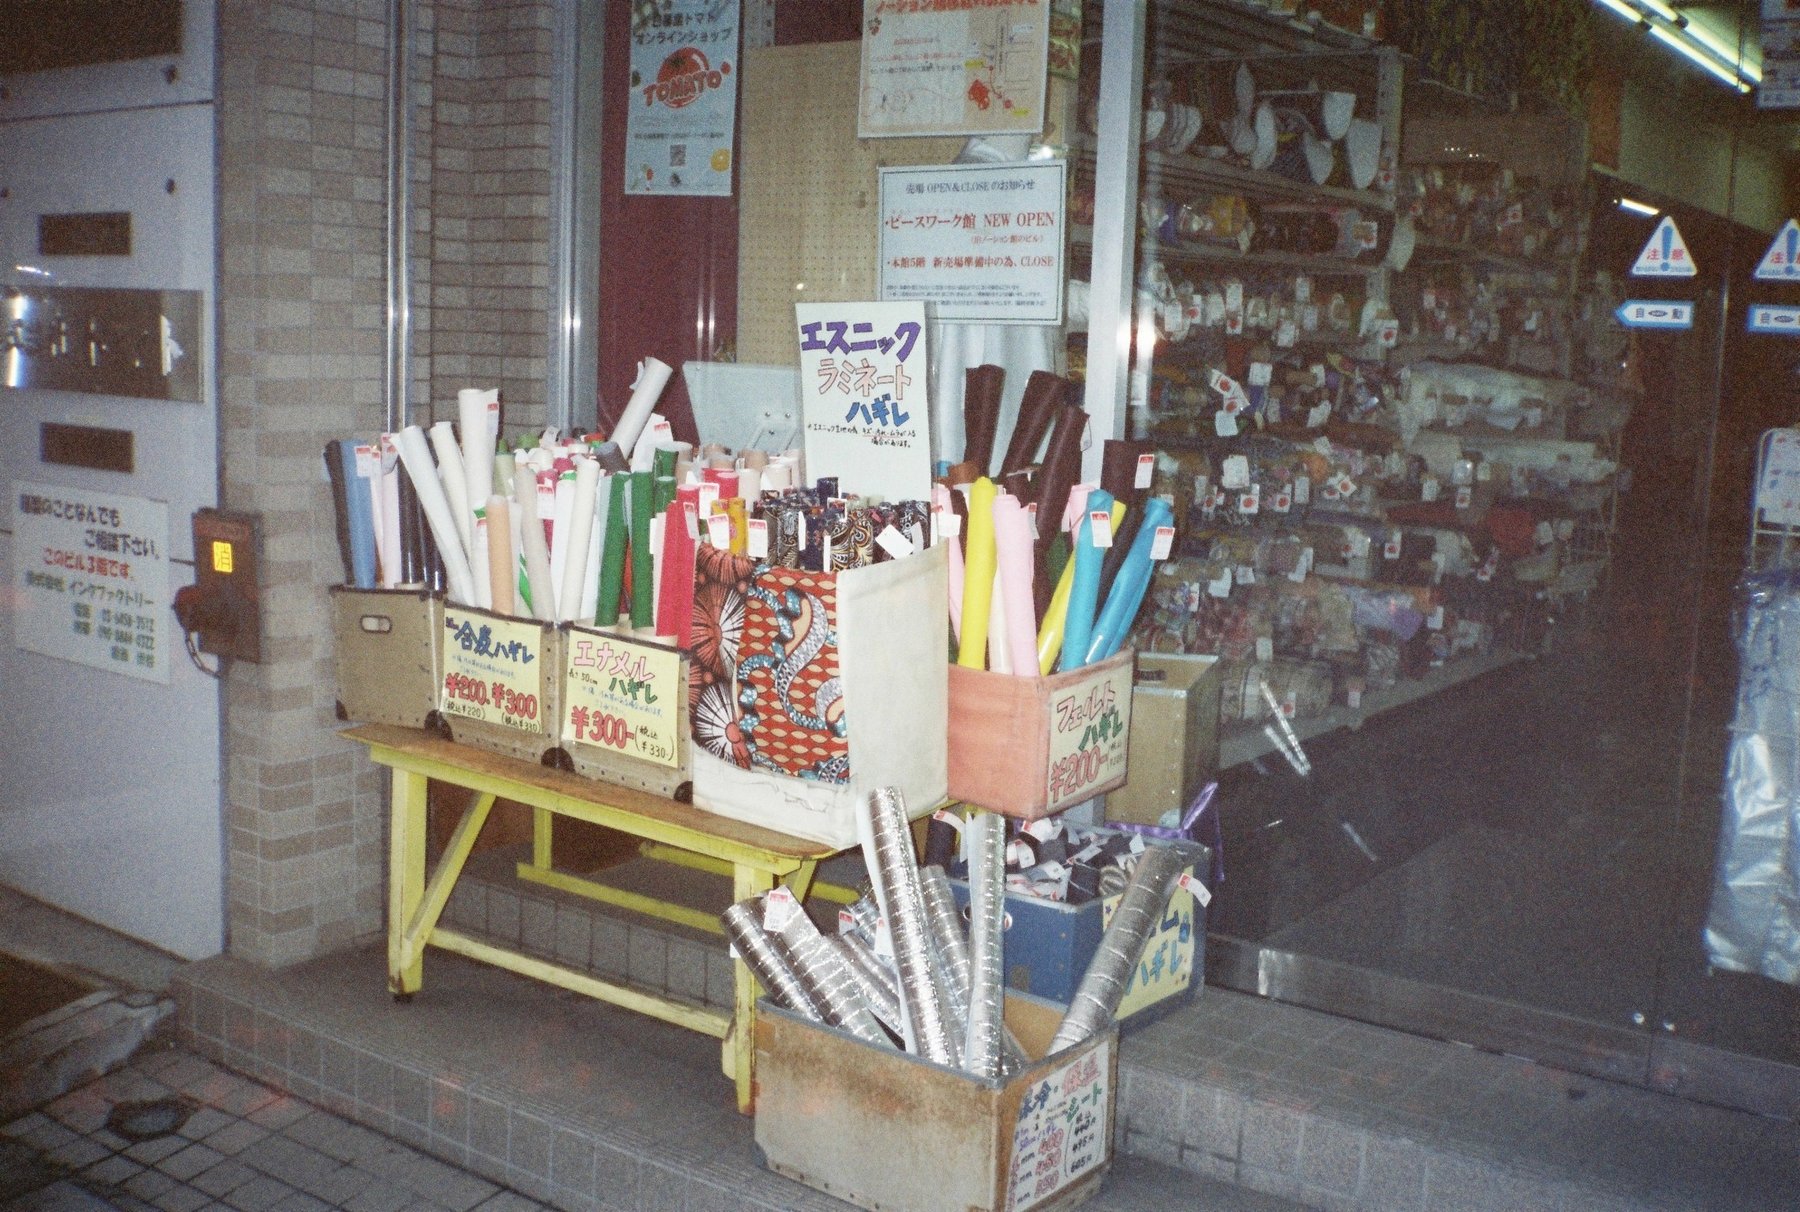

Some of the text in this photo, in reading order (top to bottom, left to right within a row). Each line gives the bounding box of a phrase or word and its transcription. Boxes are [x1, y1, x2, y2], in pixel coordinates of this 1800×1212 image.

[633, 26, 733, 45] オンラインショップ
[643, 69, 722, 107] TOMATO
[927, 181, 990, 194] OPEN&CLOSE
[991, 178, 1036, 192] のお知らせ
[984, 212, 1011, 228] NEW
[1016, 211, 1055, 228] OPEN
[1020, 255, 1055, 268] CLOSE
[1647, 249, 1685, 261] 注意
[801, 321, 922, 363] エスニック
[817, 357, 912, 401] ラミネート
[845, 393, 911, 428] ハギレ
[574, 640, 656, 683] エナメル
[609, 677, 658, 705] ハギレ
[1057, 680, 1116, 733] フェルト
[1078, 704, 1124, 752] ハギレ
